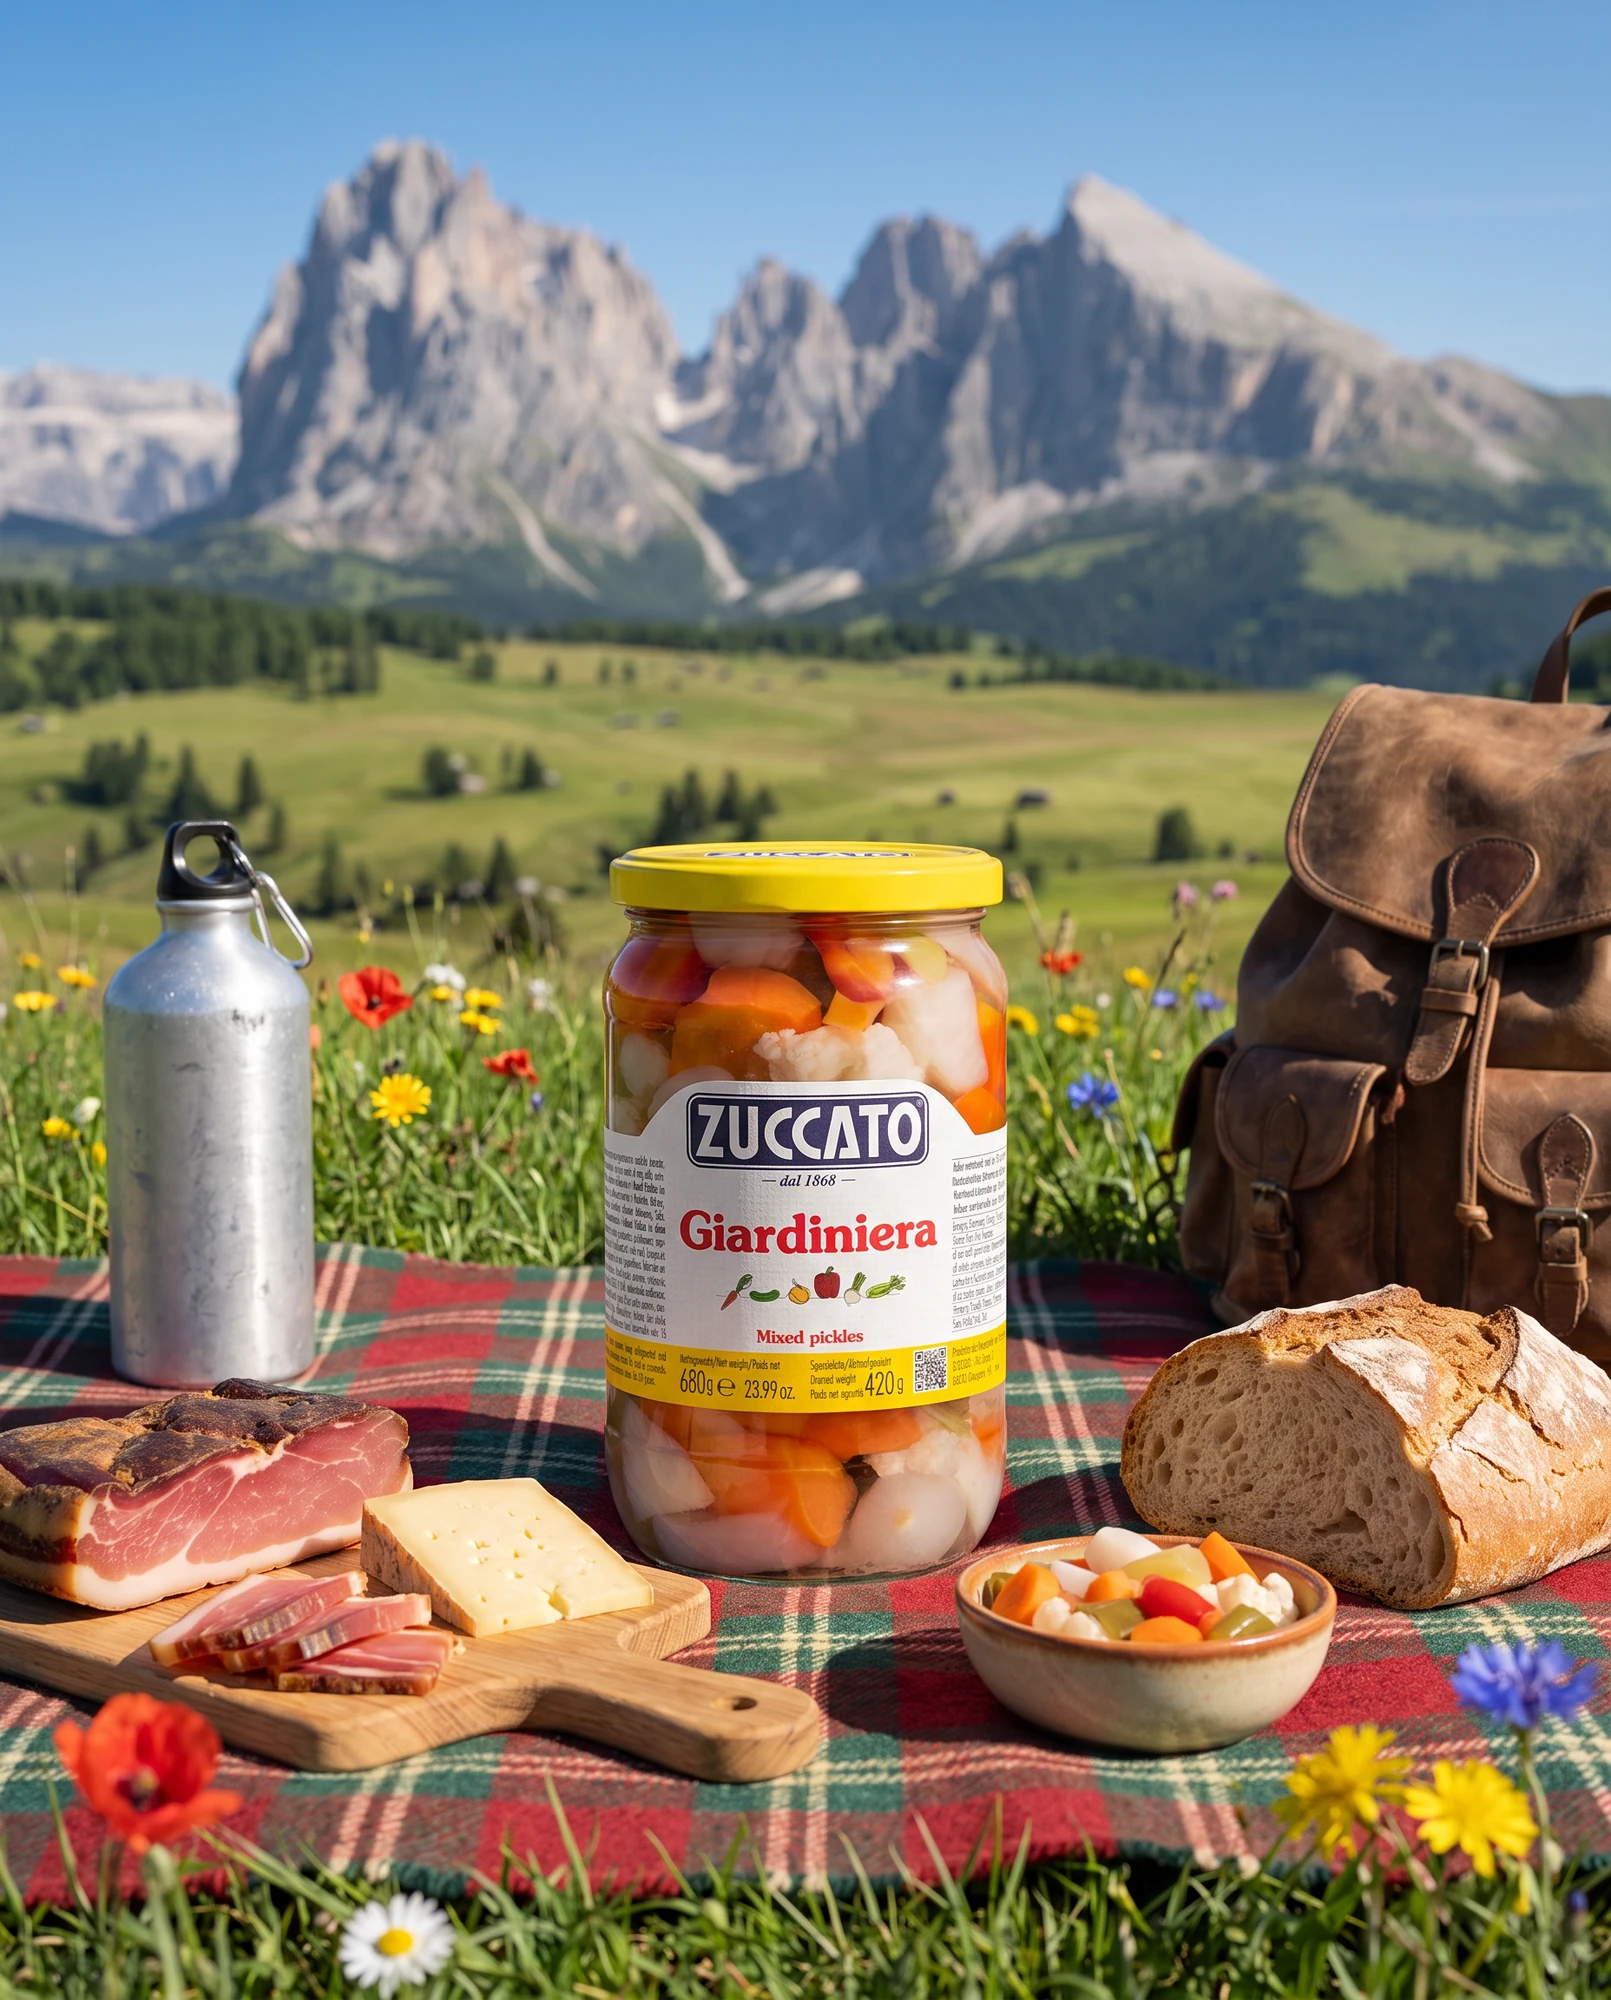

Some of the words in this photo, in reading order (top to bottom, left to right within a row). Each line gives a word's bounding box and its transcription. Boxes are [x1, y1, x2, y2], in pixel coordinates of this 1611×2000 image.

[695, 1101, 922, 1160] ZUCCATO
[779, 1174, 801, 1187] dal
[804, 1174, 837, 1187] 1868
[679, 1209, 938, 1255] Giardiniera
[756, 1329, 804, 1344] Mixed
[809, 1329, 864, 1347] pickles
